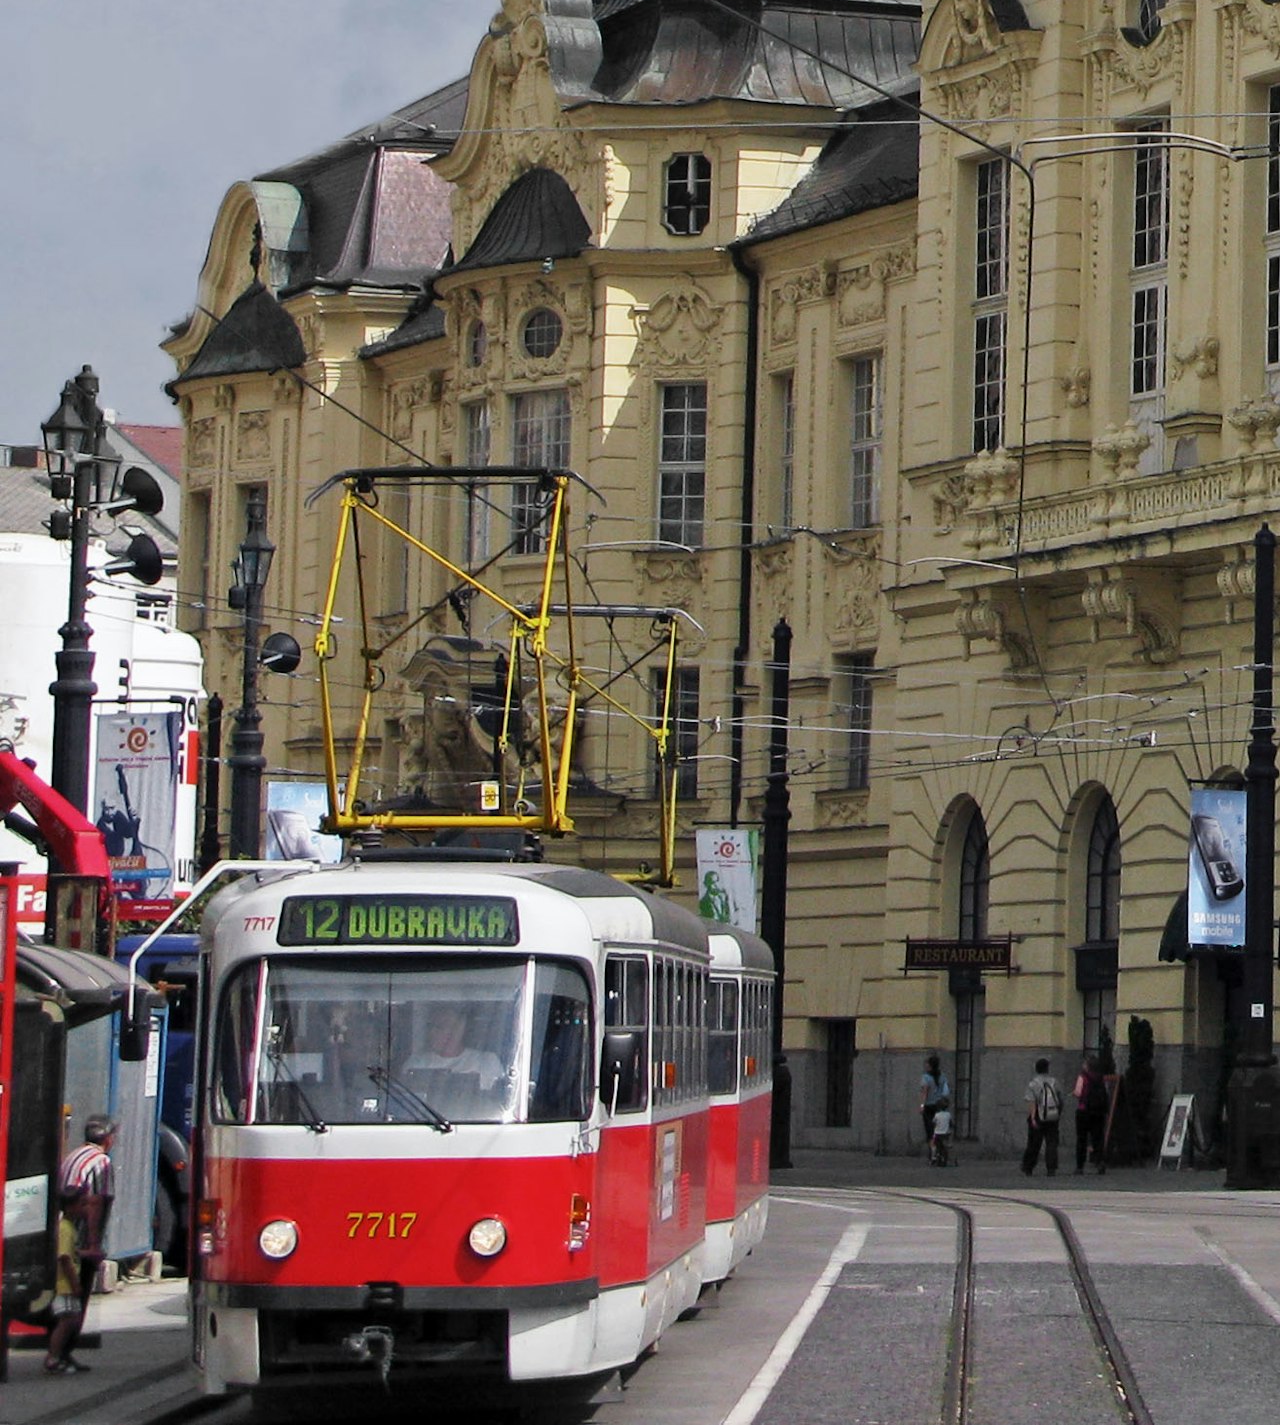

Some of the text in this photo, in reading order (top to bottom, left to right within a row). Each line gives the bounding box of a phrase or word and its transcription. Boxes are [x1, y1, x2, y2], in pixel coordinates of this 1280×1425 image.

[244, 917, 276, 932] 7717
[300, 900, 339, 939] 12
[1193, 912, 1241, 924] SAMSUNG
[1201, 925, 1234, 937] mobile
[913, 948, 1004, 963] RESTAURANT
[347, 1212, 417, 1238] 7717
